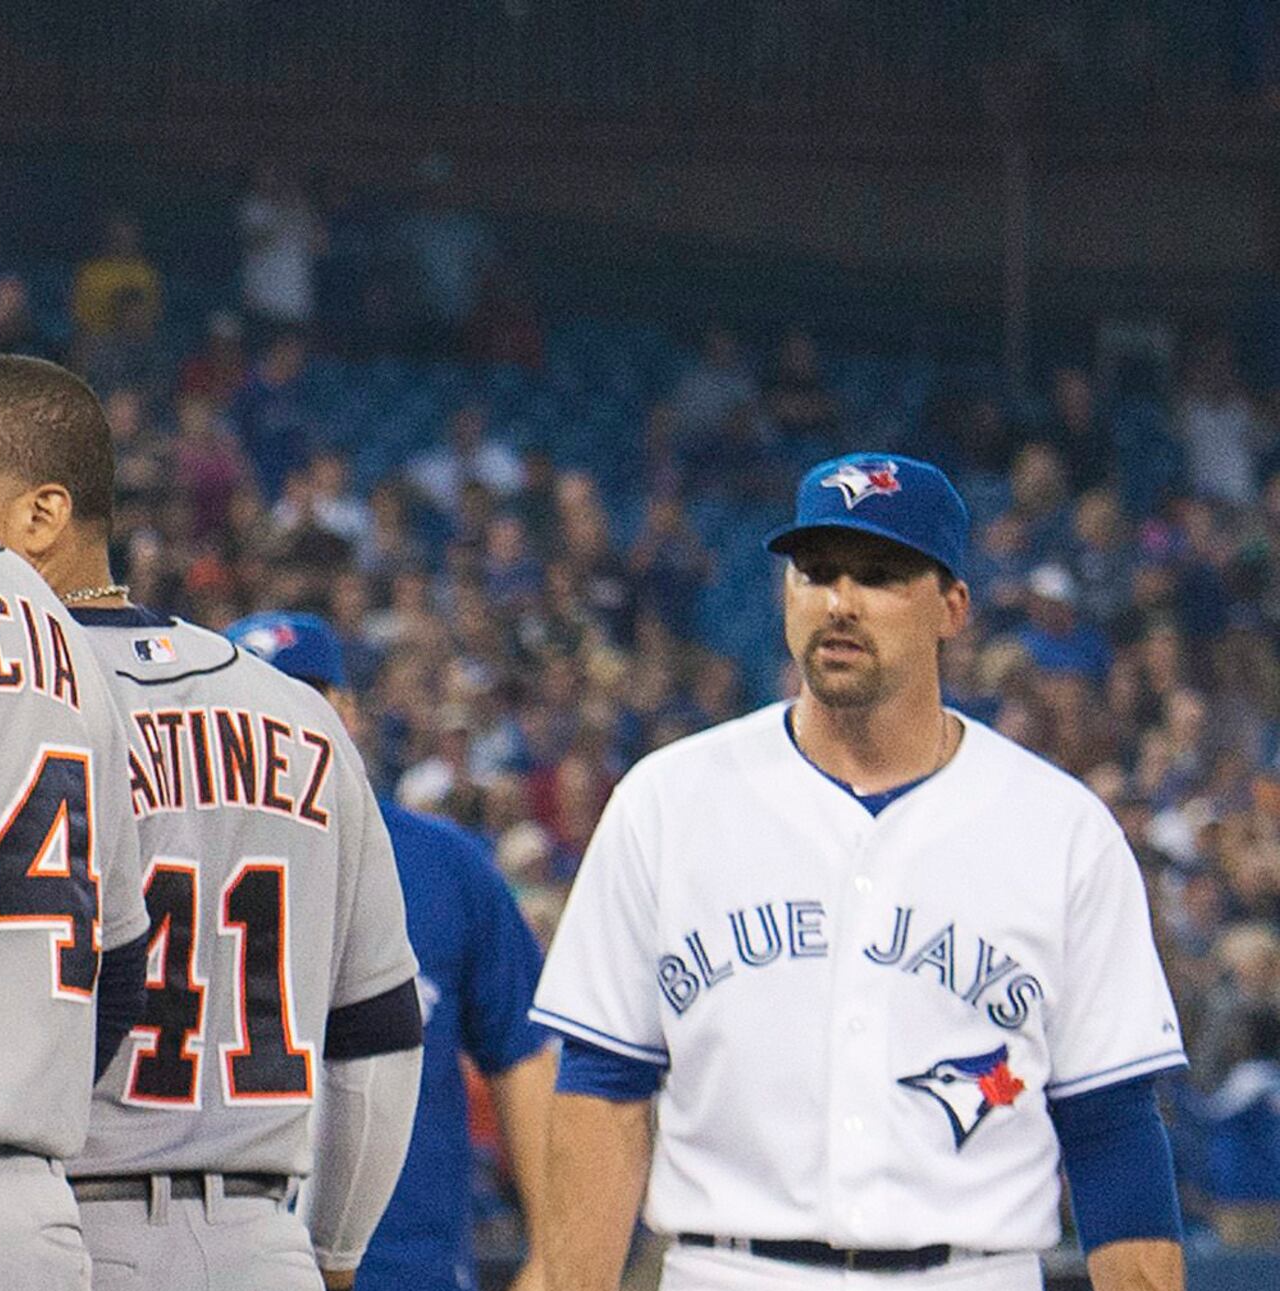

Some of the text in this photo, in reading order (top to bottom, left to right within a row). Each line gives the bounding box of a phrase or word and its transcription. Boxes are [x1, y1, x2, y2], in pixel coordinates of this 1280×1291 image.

[122, 856, 317, 1112] 41
[656, 900, 1044, 1031] BLUE JAYS
